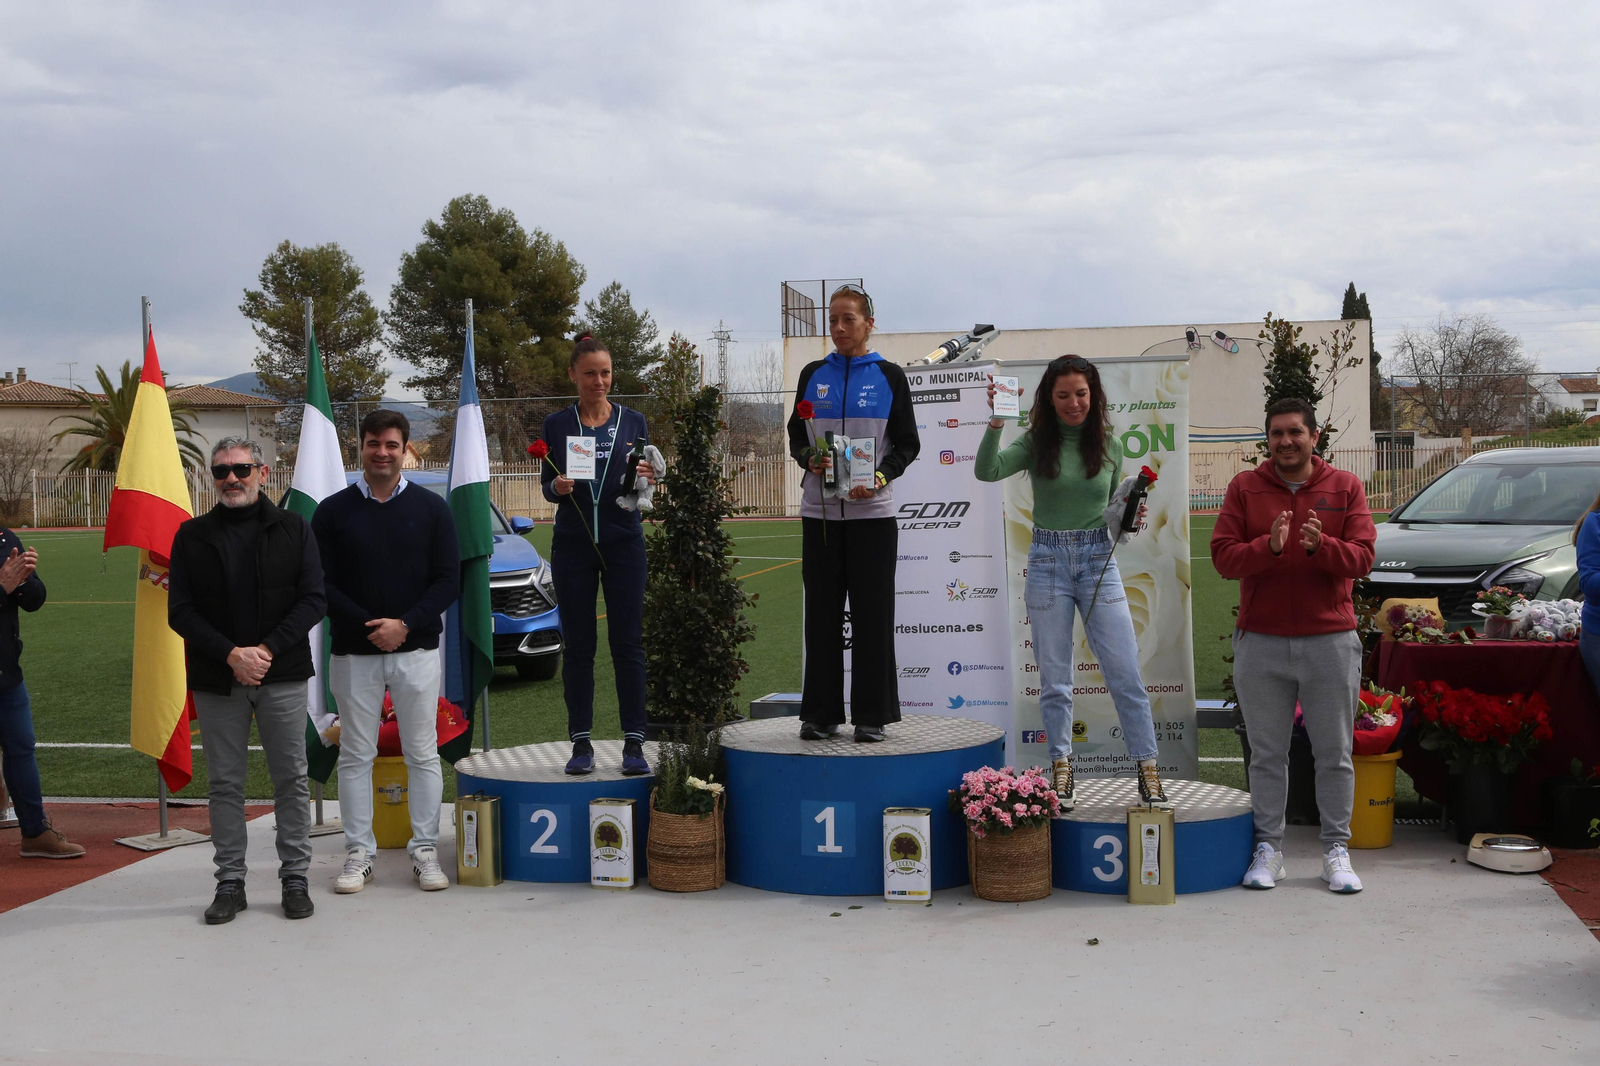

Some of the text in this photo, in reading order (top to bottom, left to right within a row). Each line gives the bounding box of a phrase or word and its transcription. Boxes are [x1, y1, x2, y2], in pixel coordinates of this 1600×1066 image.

[907, 371, 986, 386] VO MUNICIPAL
[911, 393, 958, 402] ucena.es
[1105, 400, 1177, 413] es y plantas
[1106, 424, 1175, 458] ÓN
[896, 501, 971, 519] SDM
[897, 521, 961, 530] ucena
[895, 623, 984, 634] rteslucena.es
[1078, 662, 1099, 671] dom
[1025, 683, 1184, 696] Ser acional acional
[1166, 722, 1185, 730] 505
[1168, 733, 1183, 741] 114
[530, 809, 558, 854] 2
[814, 807, 843, 853] 1
[1092, 835, 1124, 882] 3
